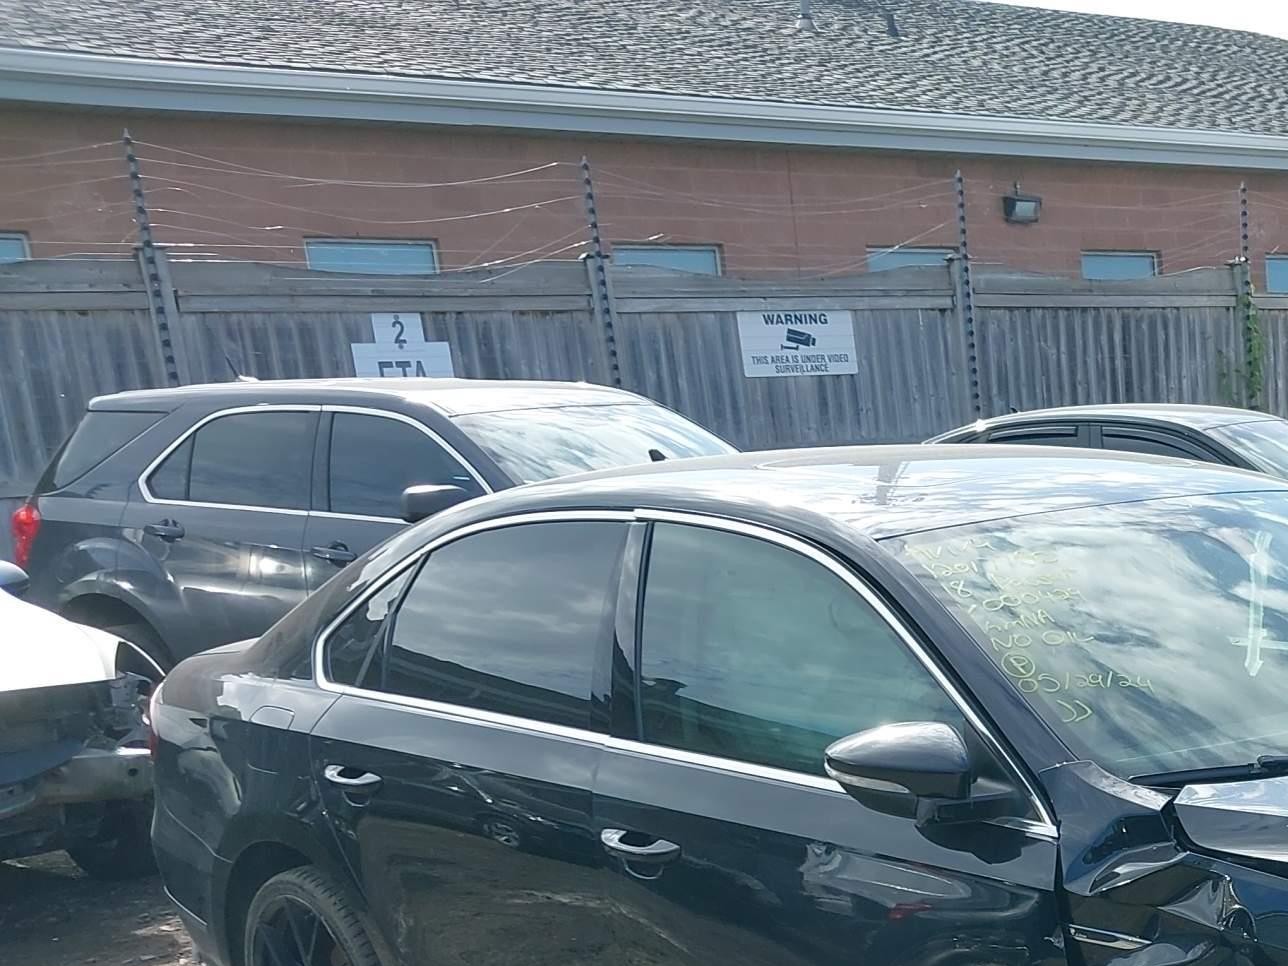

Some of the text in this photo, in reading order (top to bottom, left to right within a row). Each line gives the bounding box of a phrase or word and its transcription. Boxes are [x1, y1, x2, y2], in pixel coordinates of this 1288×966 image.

[763, 313, 828, 325] WARNING
[391, 320, 408, 344] 2
[751, 353, 849, 365] THIS AREA IS UNDER VIDEO
[775, 363, 830, 374] SURVEILLANCE
